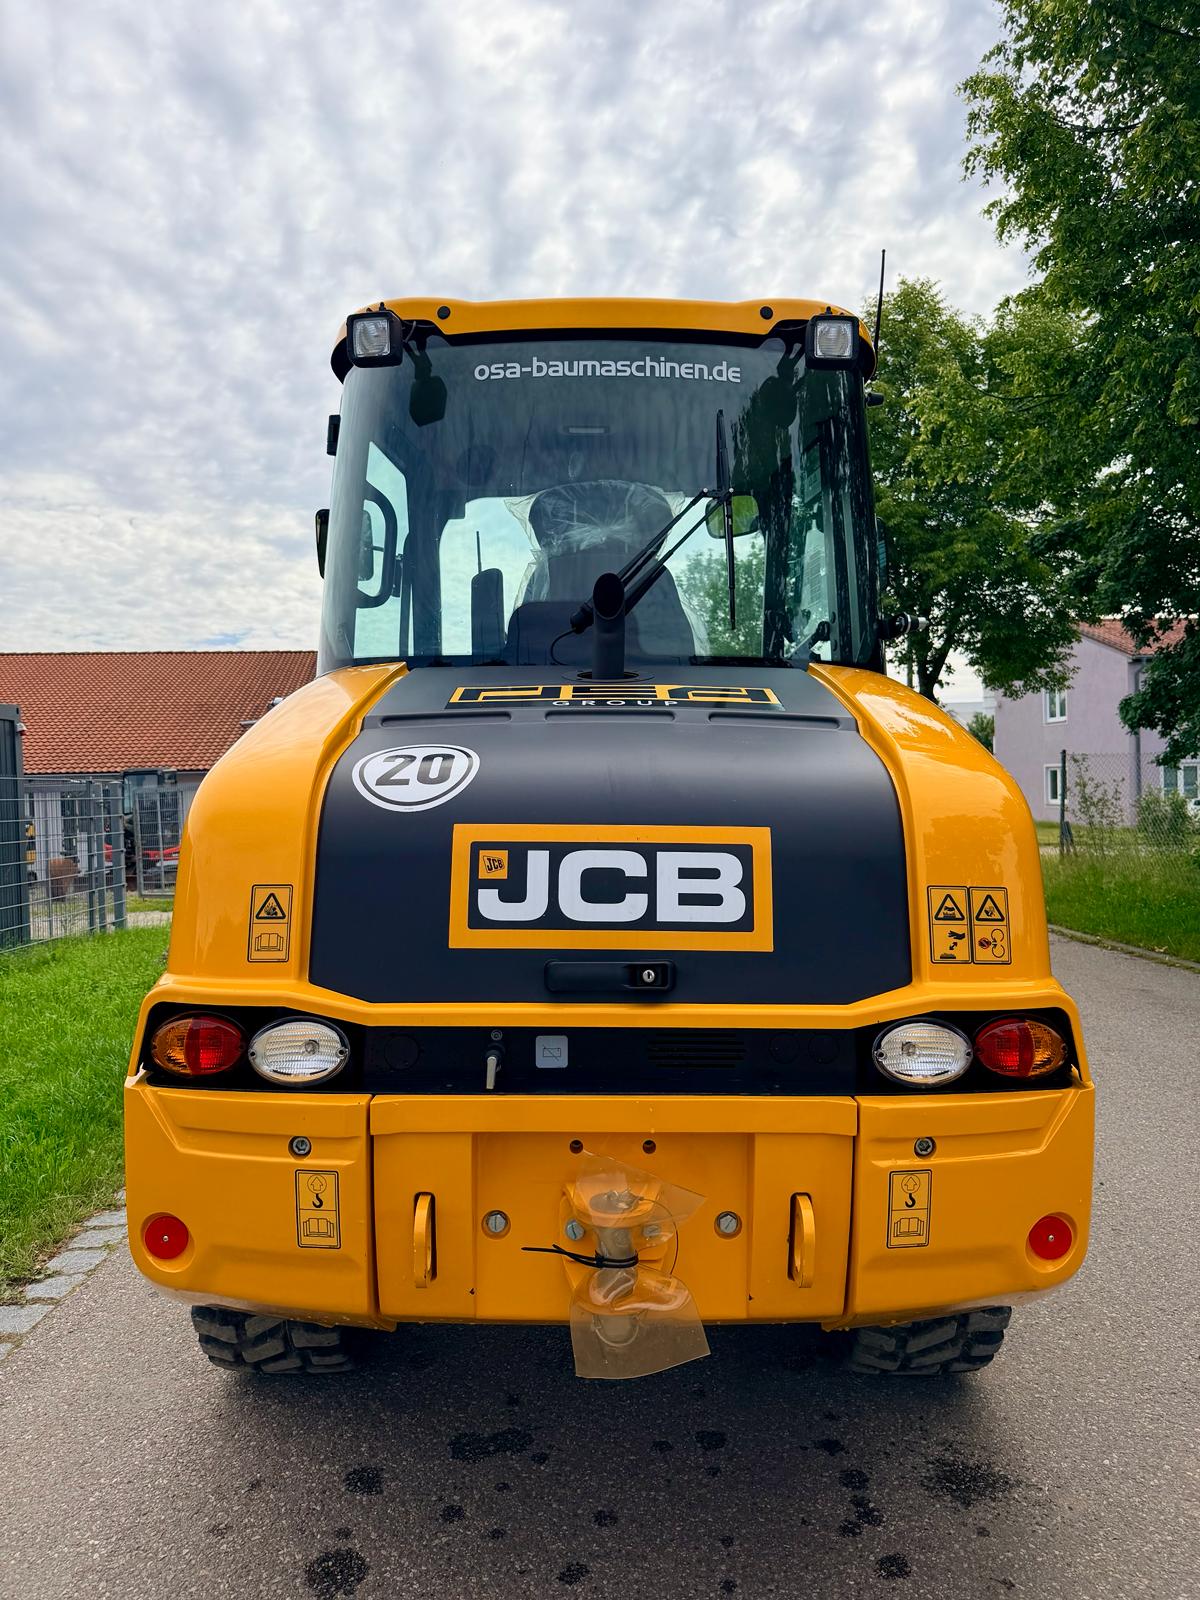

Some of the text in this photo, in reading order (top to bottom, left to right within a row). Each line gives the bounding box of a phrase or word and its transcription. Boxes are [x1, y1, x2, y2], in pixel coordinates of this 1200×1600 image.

[473, 356, 741, 383] osa-baumaschinen.de
[552, 699, 679, 707] GROUP
[375, 753, 455, 786] 20
[486, 857, 504, 871] JCB
[477, 850, 747, 922] JCB
